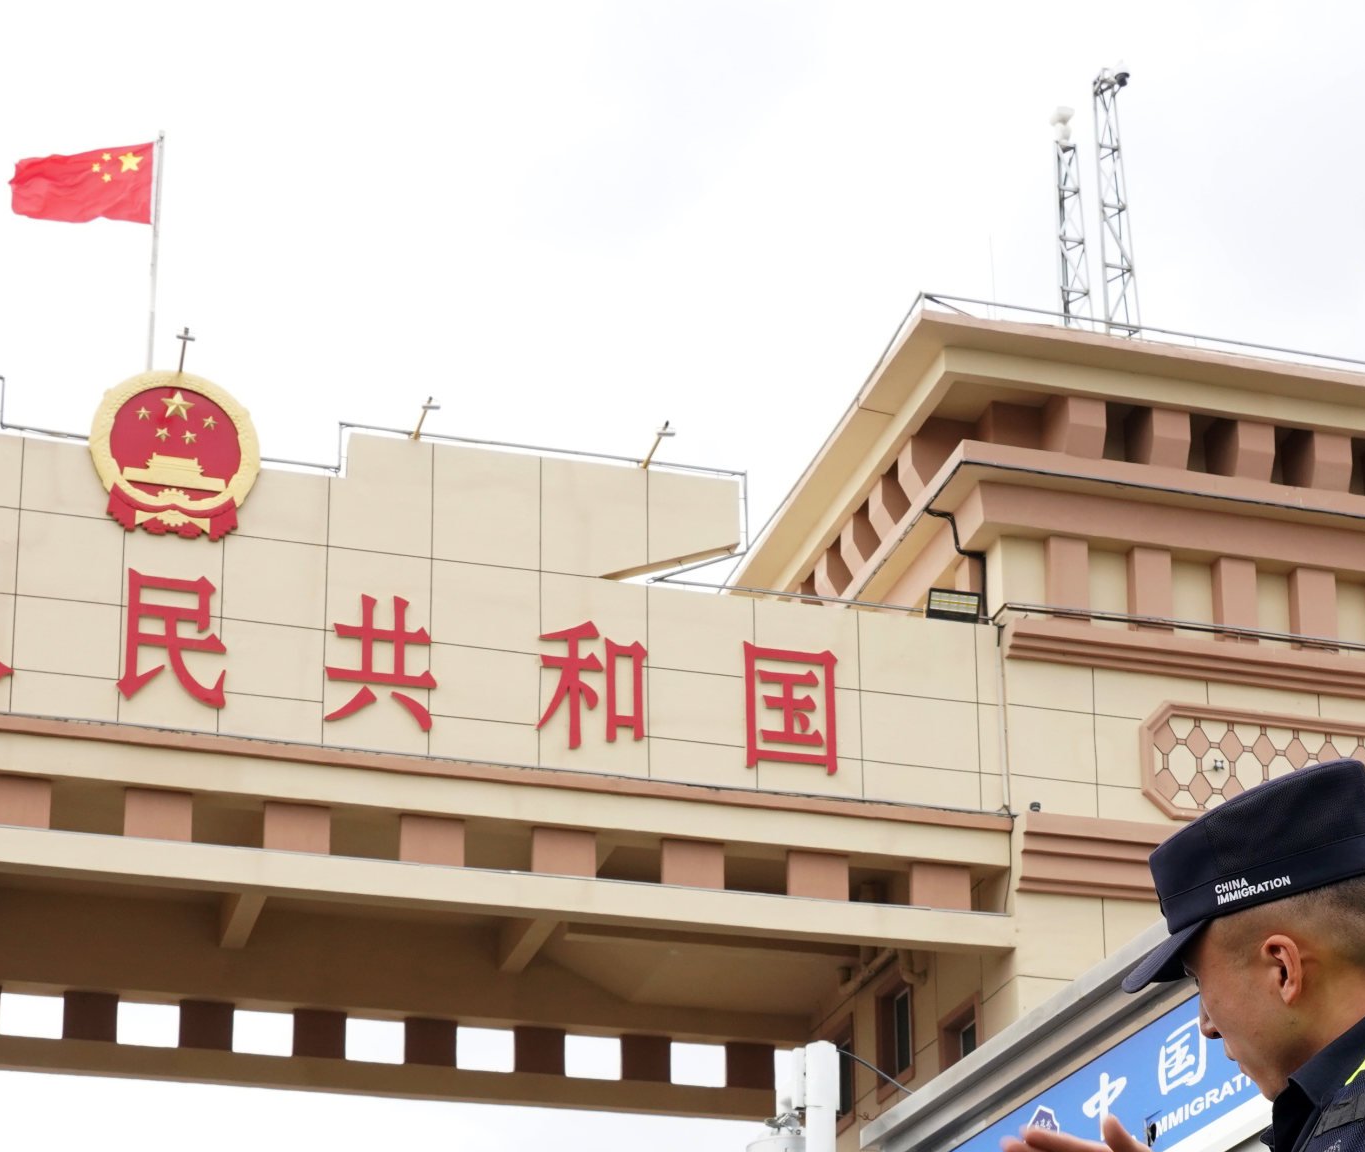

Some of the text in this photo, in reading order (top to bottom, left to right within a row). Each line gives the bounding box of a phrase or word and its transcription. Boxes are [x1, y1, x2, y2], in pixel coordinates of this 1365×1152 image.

[1214, 877, 1249, 894] CHINA
[1216, 875, 1292, 906] IMMIGRATION
[1155, 1071, 1252, 1139] MMIGRATI
